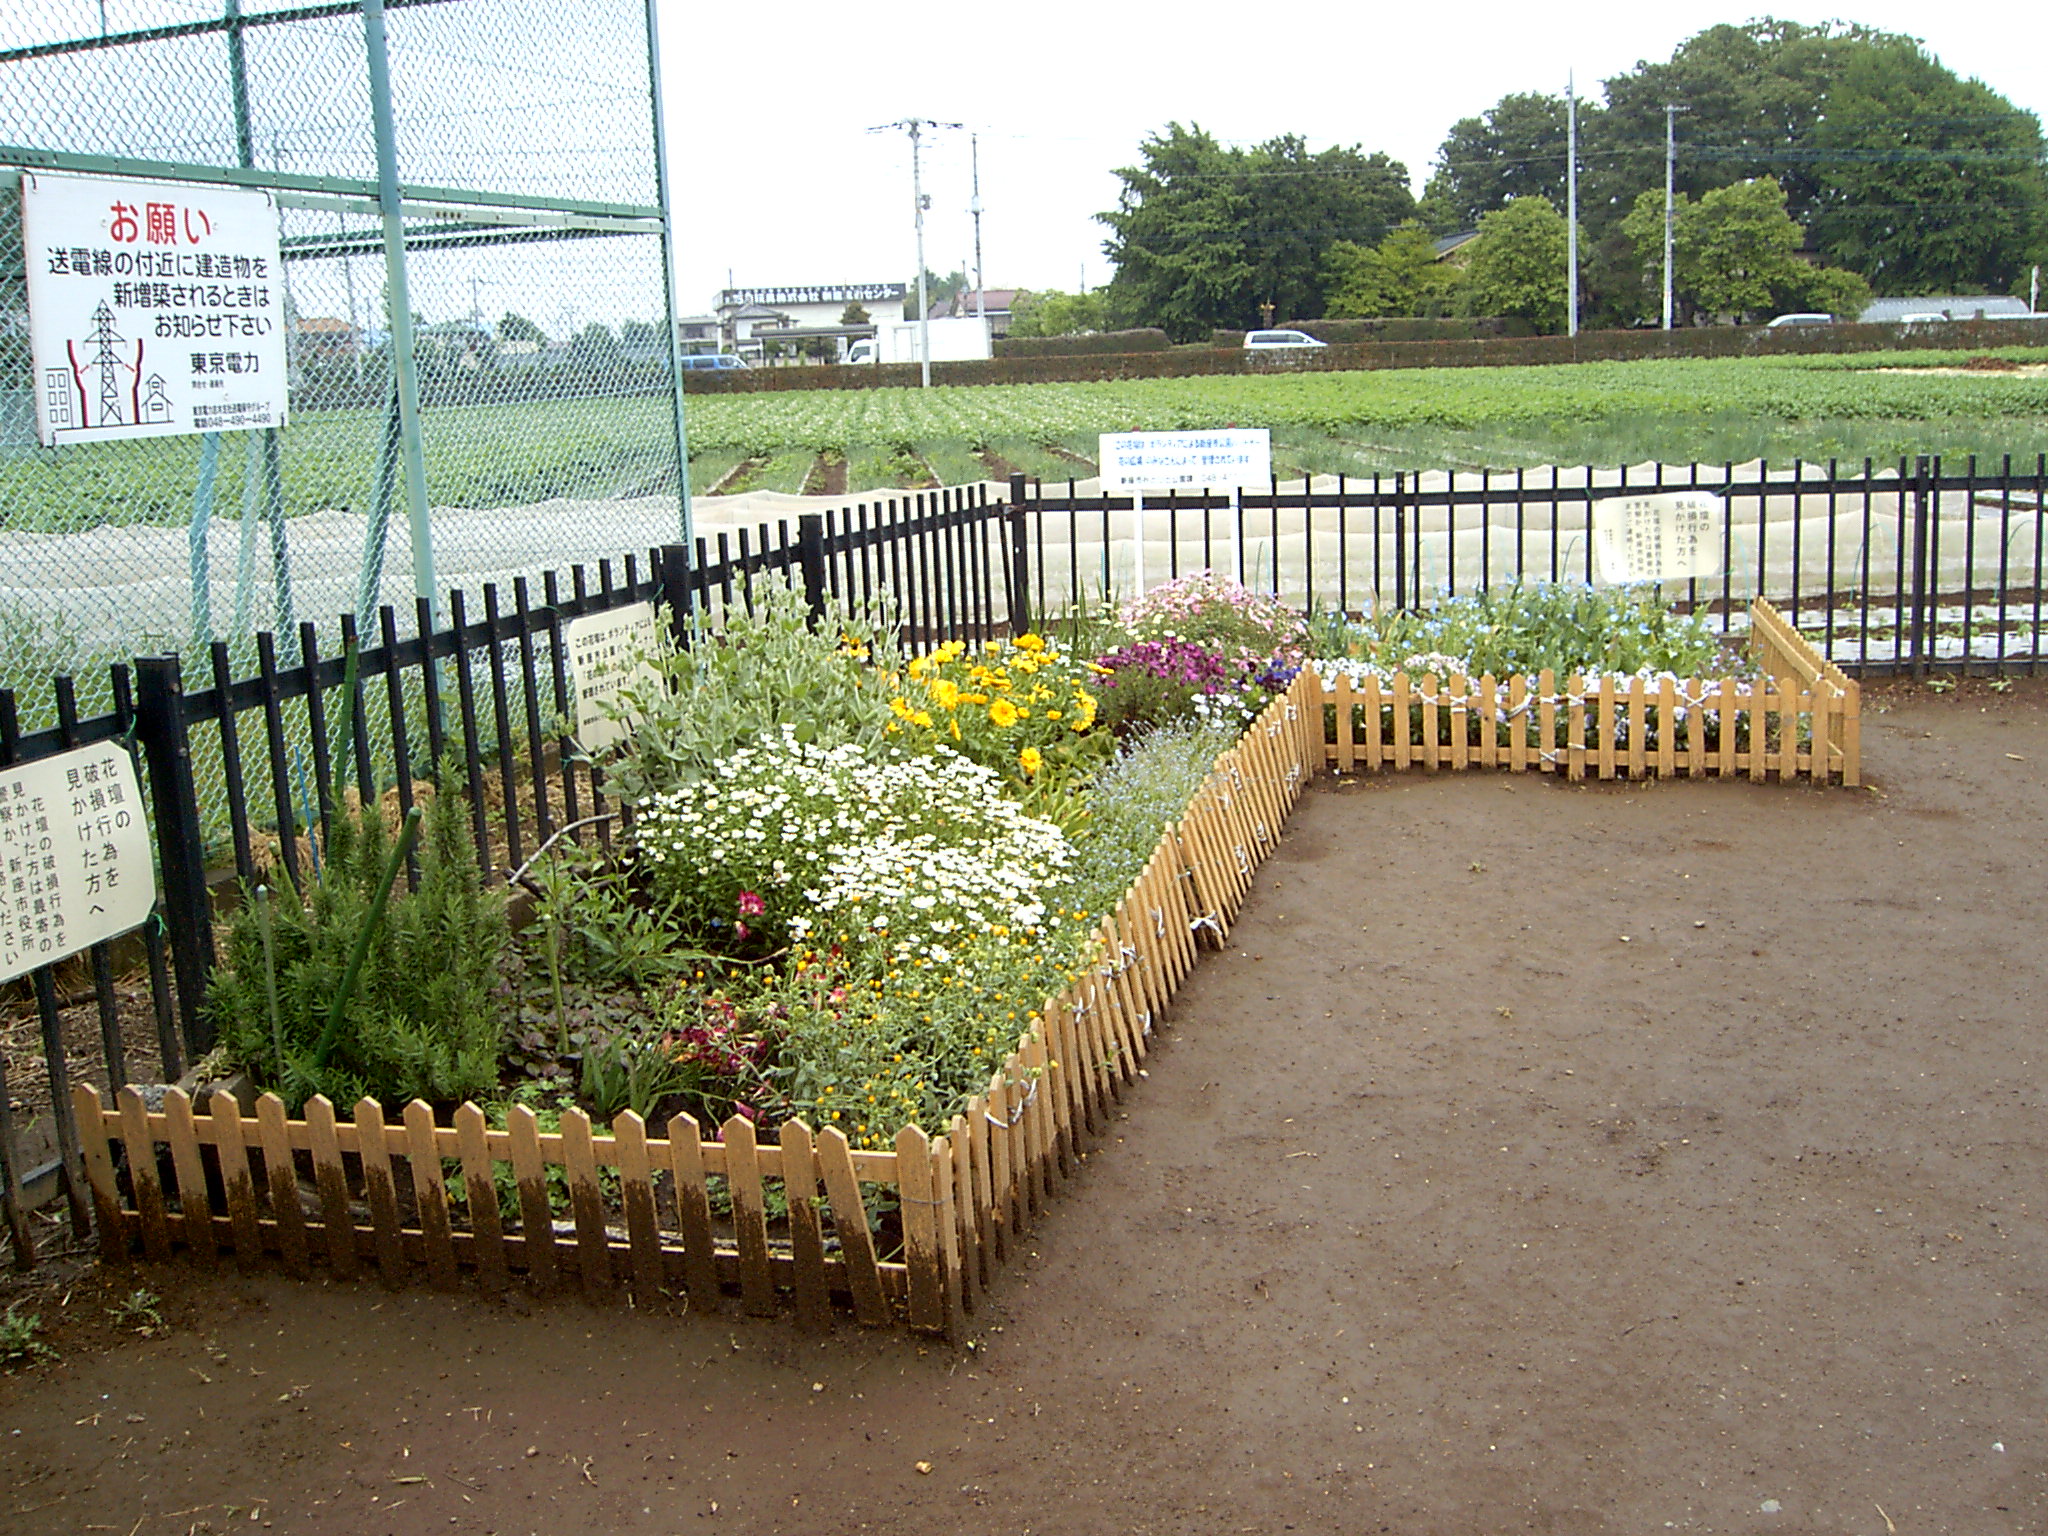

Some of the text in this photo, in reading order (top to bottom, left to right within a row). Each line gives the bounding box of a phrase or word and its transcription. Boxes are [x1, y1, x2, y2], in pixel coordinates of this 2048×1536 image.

[109, 200, 212, 245] お願い
[47, 247, 268, 278] 送電線の付近に建造物を
[113, 283, 270, 309] 新増築されるときは
[155, 315, 271, 338] お知らせ下さい
[190, 352, 259, 374] 東京電力
[101, 758, 132, 828] 花壇の
[65, 769, 104, 915] 見かけた方へ
[83, 765, 120, 888] 破損行為を
[12, 781, 52, 953] 見かけた方は最寄の
[31, 797, 66, 948] 花壇の破損行為を
